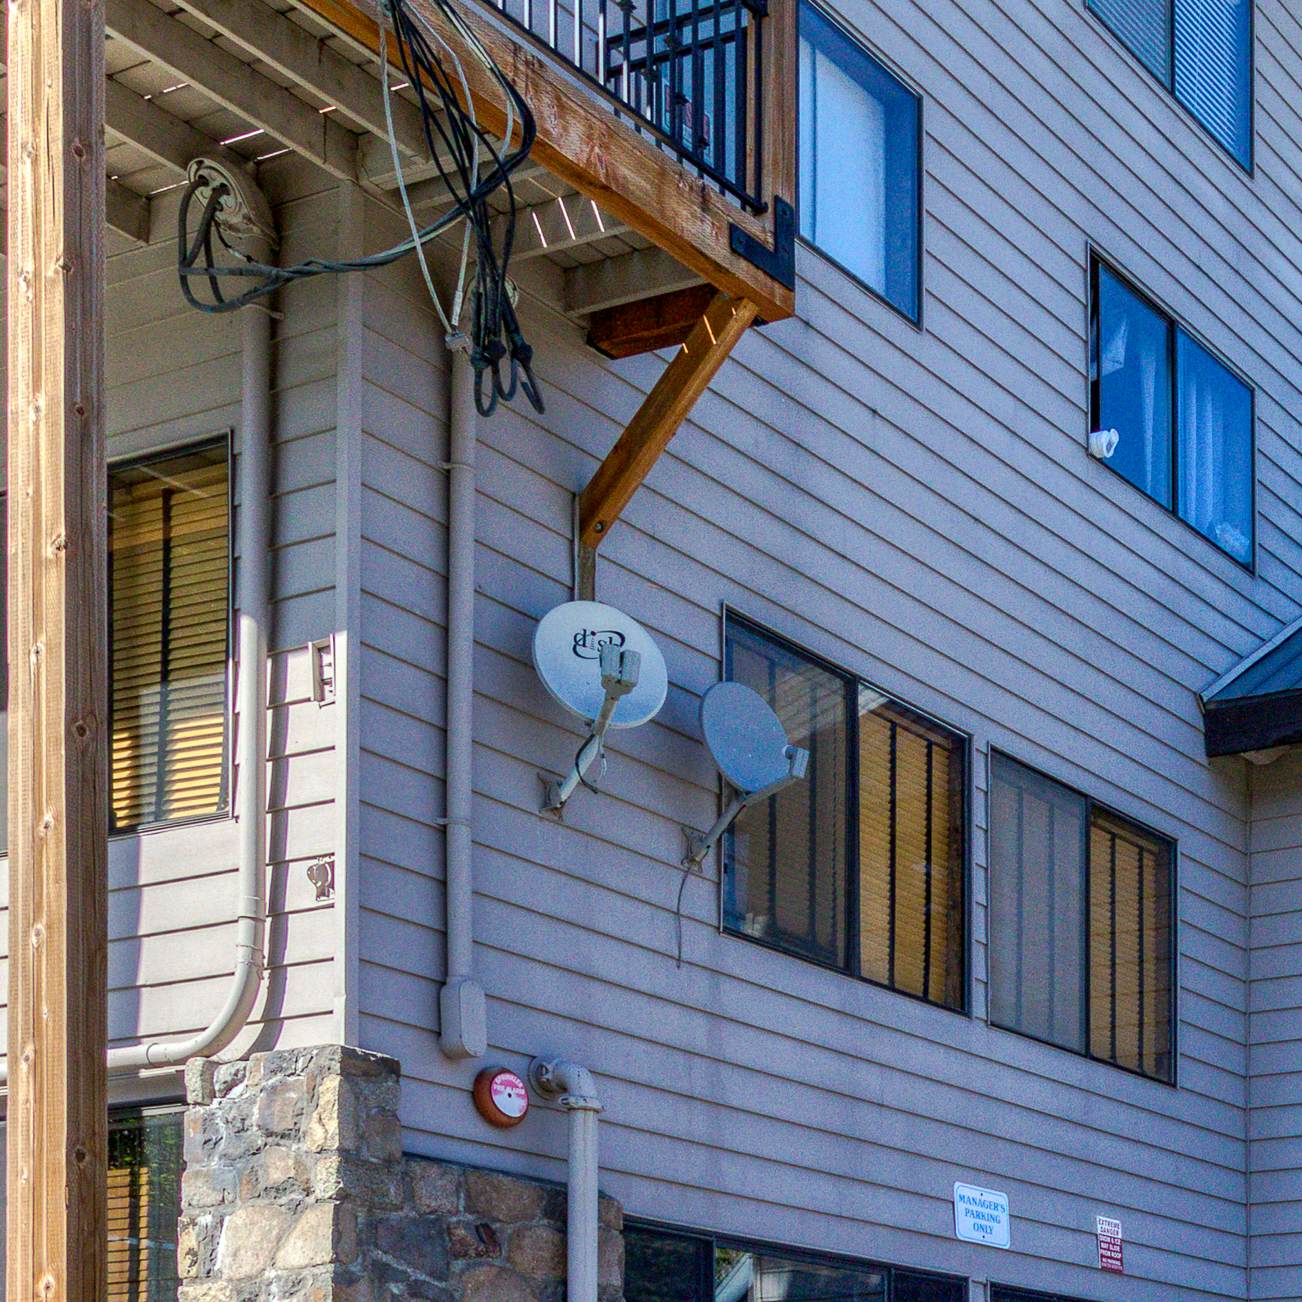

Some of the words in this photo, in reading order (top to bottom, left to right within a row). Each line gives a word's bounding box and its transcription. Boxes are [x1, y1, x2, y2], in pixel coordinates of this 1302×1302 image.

[958, 1194, 1006, 1213] MANAGER'S
[965, 1208, 1001, 1224] PARKING
[973, 1223, 993, 1235] ONLY
